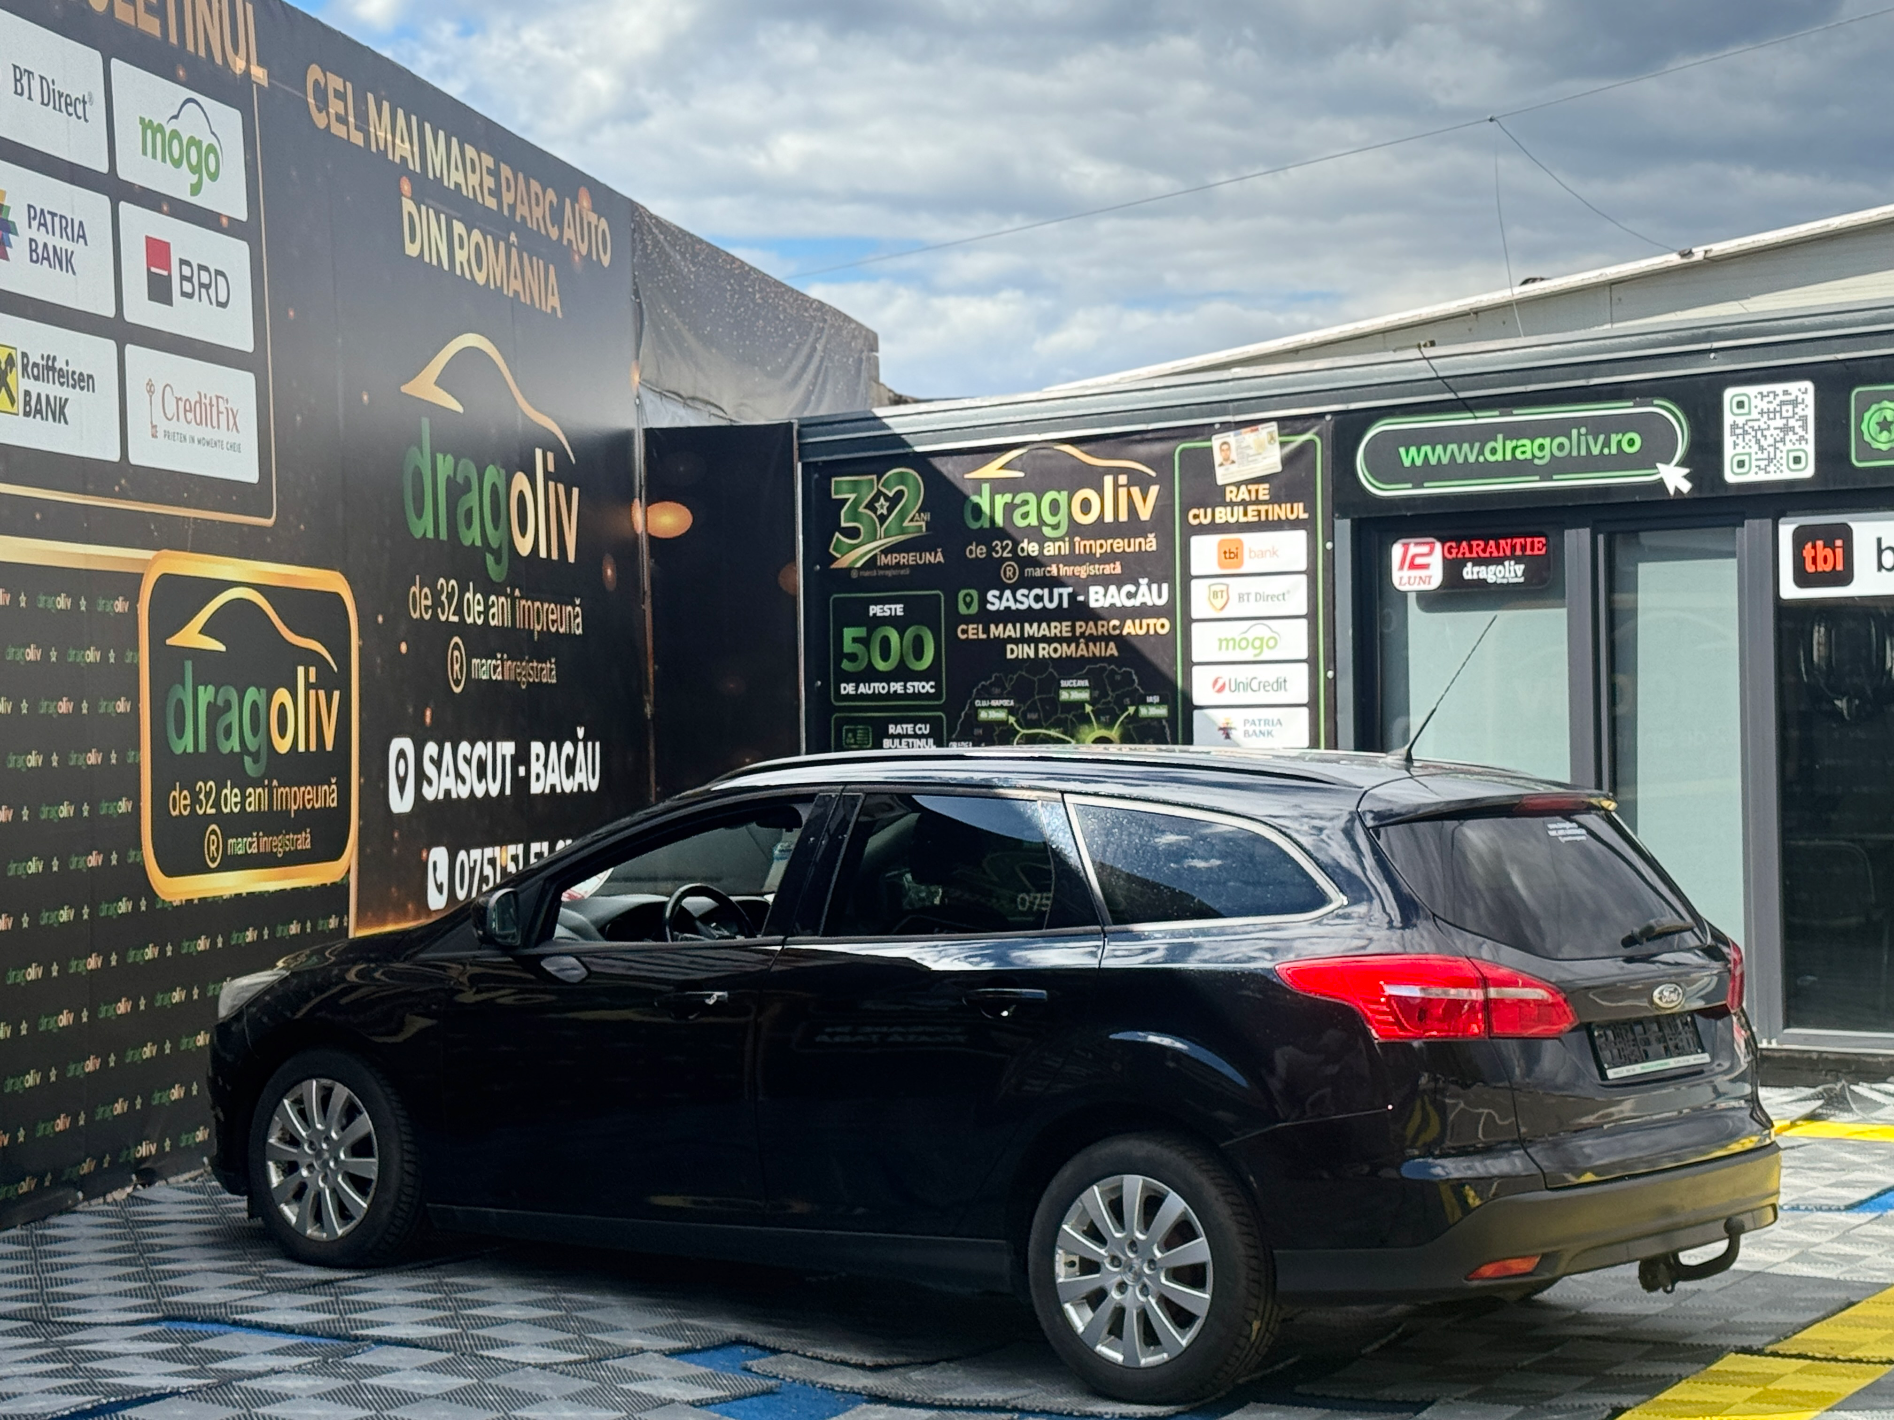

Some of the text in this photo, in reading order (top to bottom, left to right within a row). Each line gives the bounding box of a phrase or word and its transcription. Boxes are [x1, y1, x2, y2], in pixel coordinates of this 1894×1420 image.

[12, 63, 35, 102] BT
[139, 115, 221, 197] mogo
[307, 64, 612, 268] CEL MAI MARE PARC AUTO
[27, 203, 88, 247] PATRIA
[28, 237, 77, 276] BANK
[402, 197, 563, 319] DIN ROMÂNIA
[178, 257, 231, 310] BRD
[21, 351, 96, 393] Raiffeisen
[23, 389, 69, 425] BANK
[161, 383, 240, 434] CreditFix
[1399, 427, 1643, 468] www.dragoliv.ro
[403, 417, 579, 582] dragoliv
[963, 474, 1160, 538] dragoliv
[1225, 483, 1270, 502] RATE
[829, 467, 924, 558] 32
[913, 512, 931, 522] ANI
[1188, 502, 1309, 525] CU BULETINUL
[877, 548, 945, 567] ÎMPREUNĂ
[966, 533, 1157, 559] de 32 de ani împreună
[1223, 546, 1280, 560] tbi bank
[1398, 542, 1436, 571] 12
[1443, 537, 1548, 559] GARANTIE
[1802, 539, 1845, 574] tbi
[1024, 562, 1057, 578] marcă
[1059, 561, 1122, 578] înregistrată
[1398, 575, 1433, 587] LUNI
[1462, 560, 1526, 584] dragoliv
[409, 575, 583, 641] de 32 de ani împreună
[986, 587, 1073, 611] SASCUT
[1089, 578, 1169, 608] BACĂU
[1213, 590, 1225, 600] BT
[1238, 592, 1252, 603] BT
[869, 604, 904, 617] PESTE
[957, 618, 1171, 639] CEL MAI MARE PARC AUTO
[841, 625, 934, 673] 500
[1006, 639, 1118, 659] DIN ROMÂNIA
[1218, 635, 1279, 658] mogo
[471, 653, 503, 681] marcă
[840, 681, 936, 695] DE AUTO PE STOC
[1228, 676, 1288, 693] UniCredit
[166, 660, 340, 777] dragoliv
[888, 724, 930, 735] RATE CU
[1243, 718, 1283, 728] PATRIA
[882, 738, 937, 749] BULETINUL
[1243, 728, 1275, 739] BANK
[422, 741, 516, 801] SASCUT
[530, 726, 601, 795] BACĂU
[170, 777, 338, 818] de 32 de ani împreună
[228, 831, 257, 855] marcă
